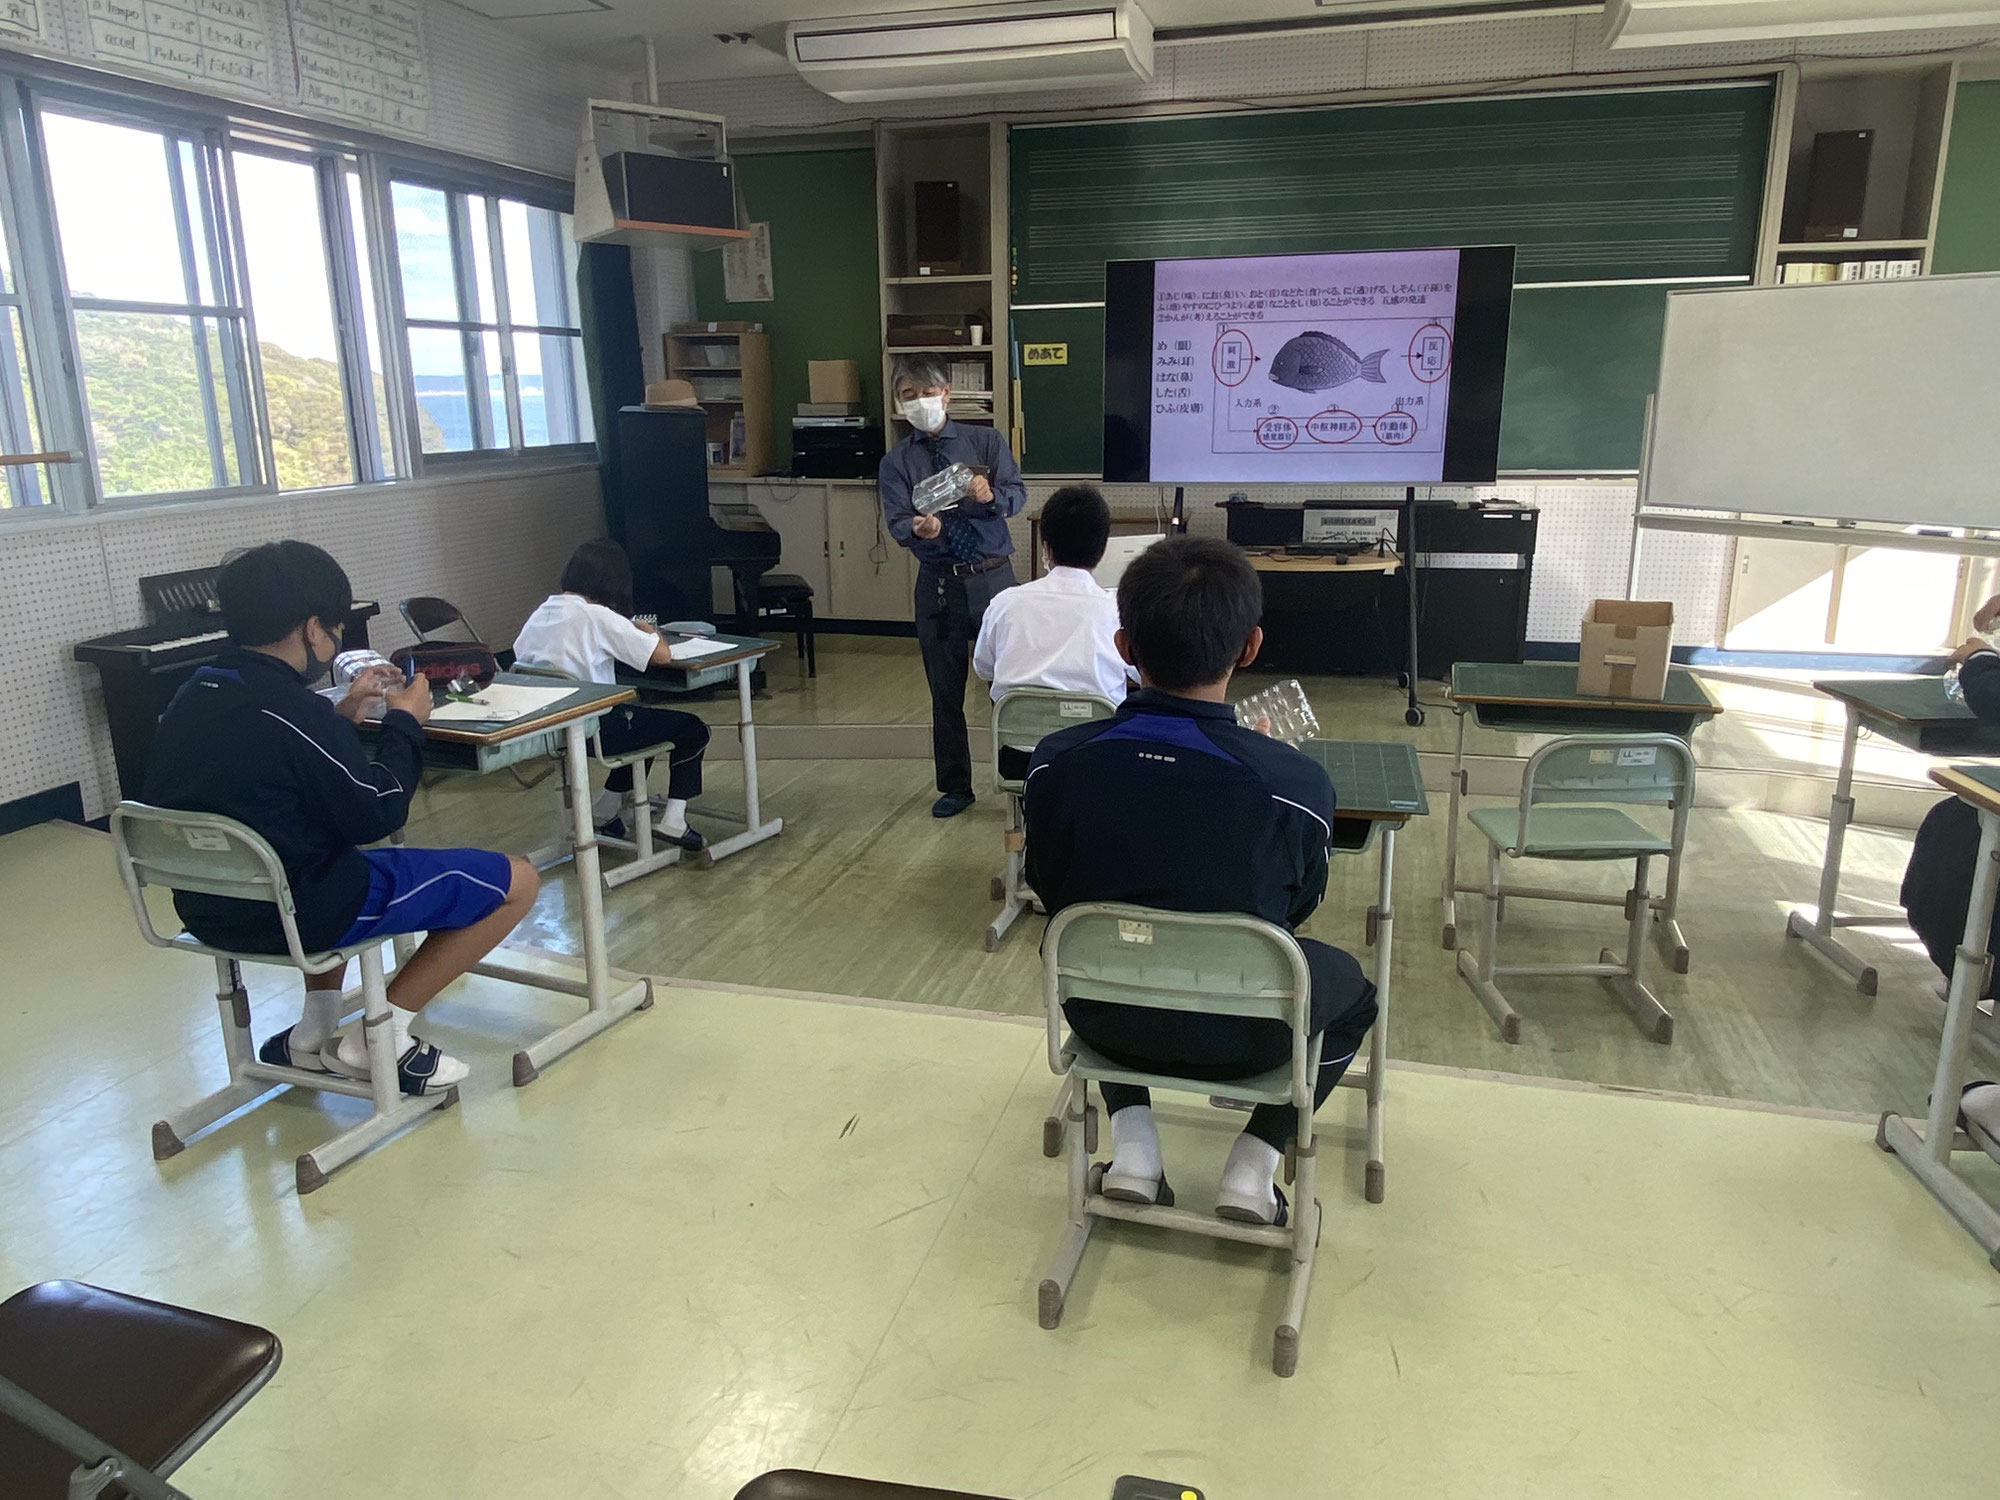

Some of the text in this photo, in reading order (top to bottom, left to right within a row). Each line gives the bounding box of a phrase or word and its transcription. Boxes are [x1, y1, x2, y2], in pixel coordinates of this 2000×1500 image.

[1028, 347, 1063, 360] めあて
[1427, 341, 1438, 365] 反応
[1157, 356, 1194, 367] みみ(耳)
[1157, 372, 1193, 382] はな(鼻)
[1156, 388, 1190, 398] した(舌)
[1234, 398, 1262, 408] 入力系
[1156, 403, 1203, 414] ひふ(皮膚)
[1268, 404, 1279, 416] ②
[1265, 422, 1292, 432] 受容体
[1311, 422, 1357, 432] 中枢神経系
[1380, 421, 1408, 431] 作動体
